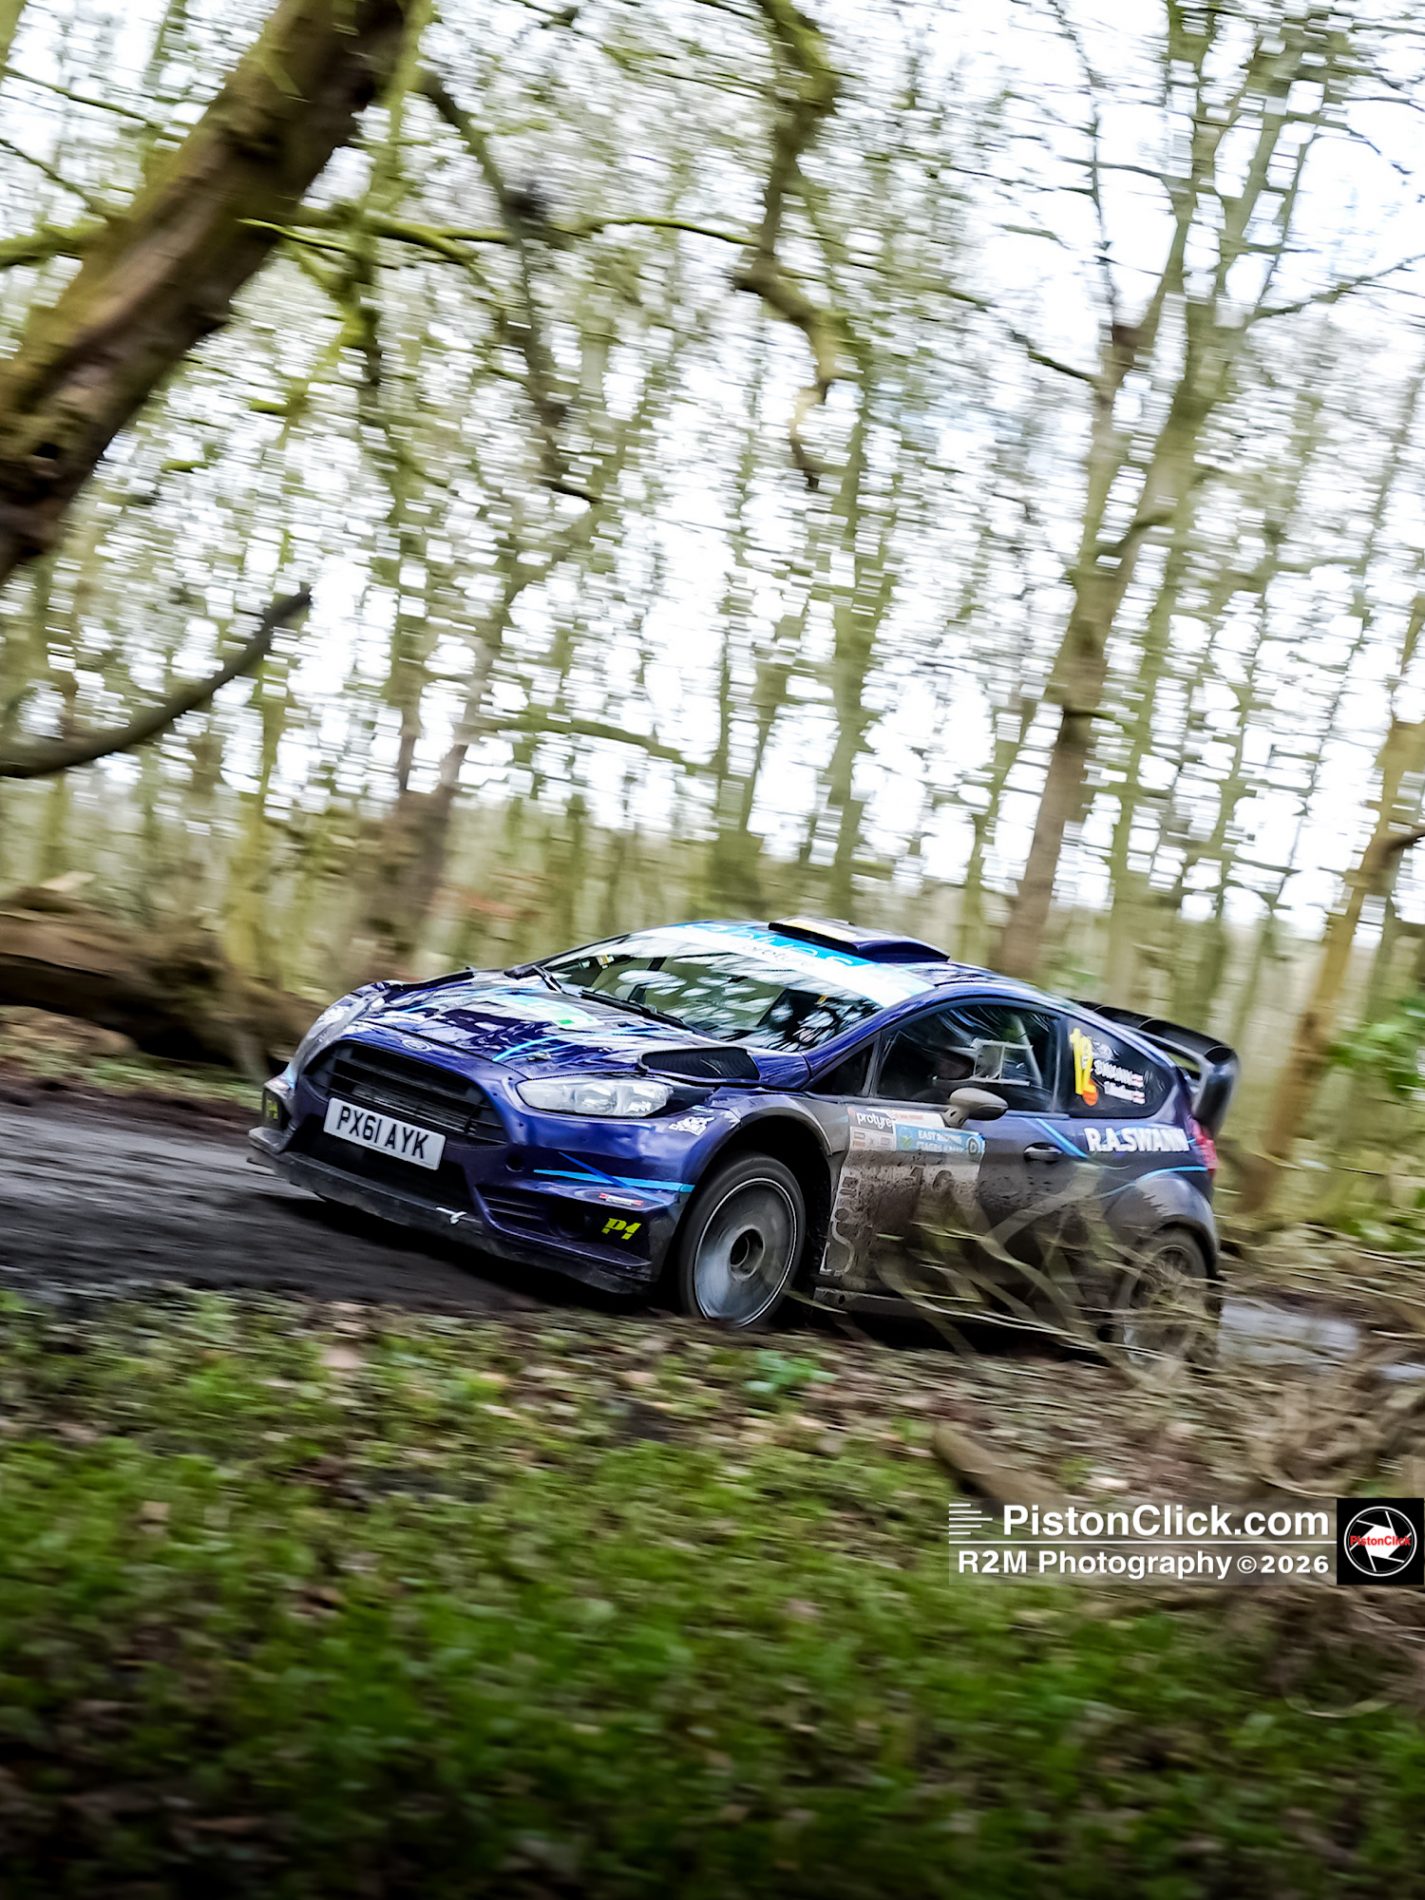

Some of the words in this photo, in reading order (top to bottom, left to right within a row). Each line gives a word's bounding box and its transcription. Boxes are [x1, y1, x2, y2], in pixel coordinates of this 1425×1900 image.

[336, 1105, 382, 1144] PX61
[384, 1123, 430, 1160] AYK
[856, 1112, 894, 1130] protyre
[601, 1217, 642, 1240] P1
